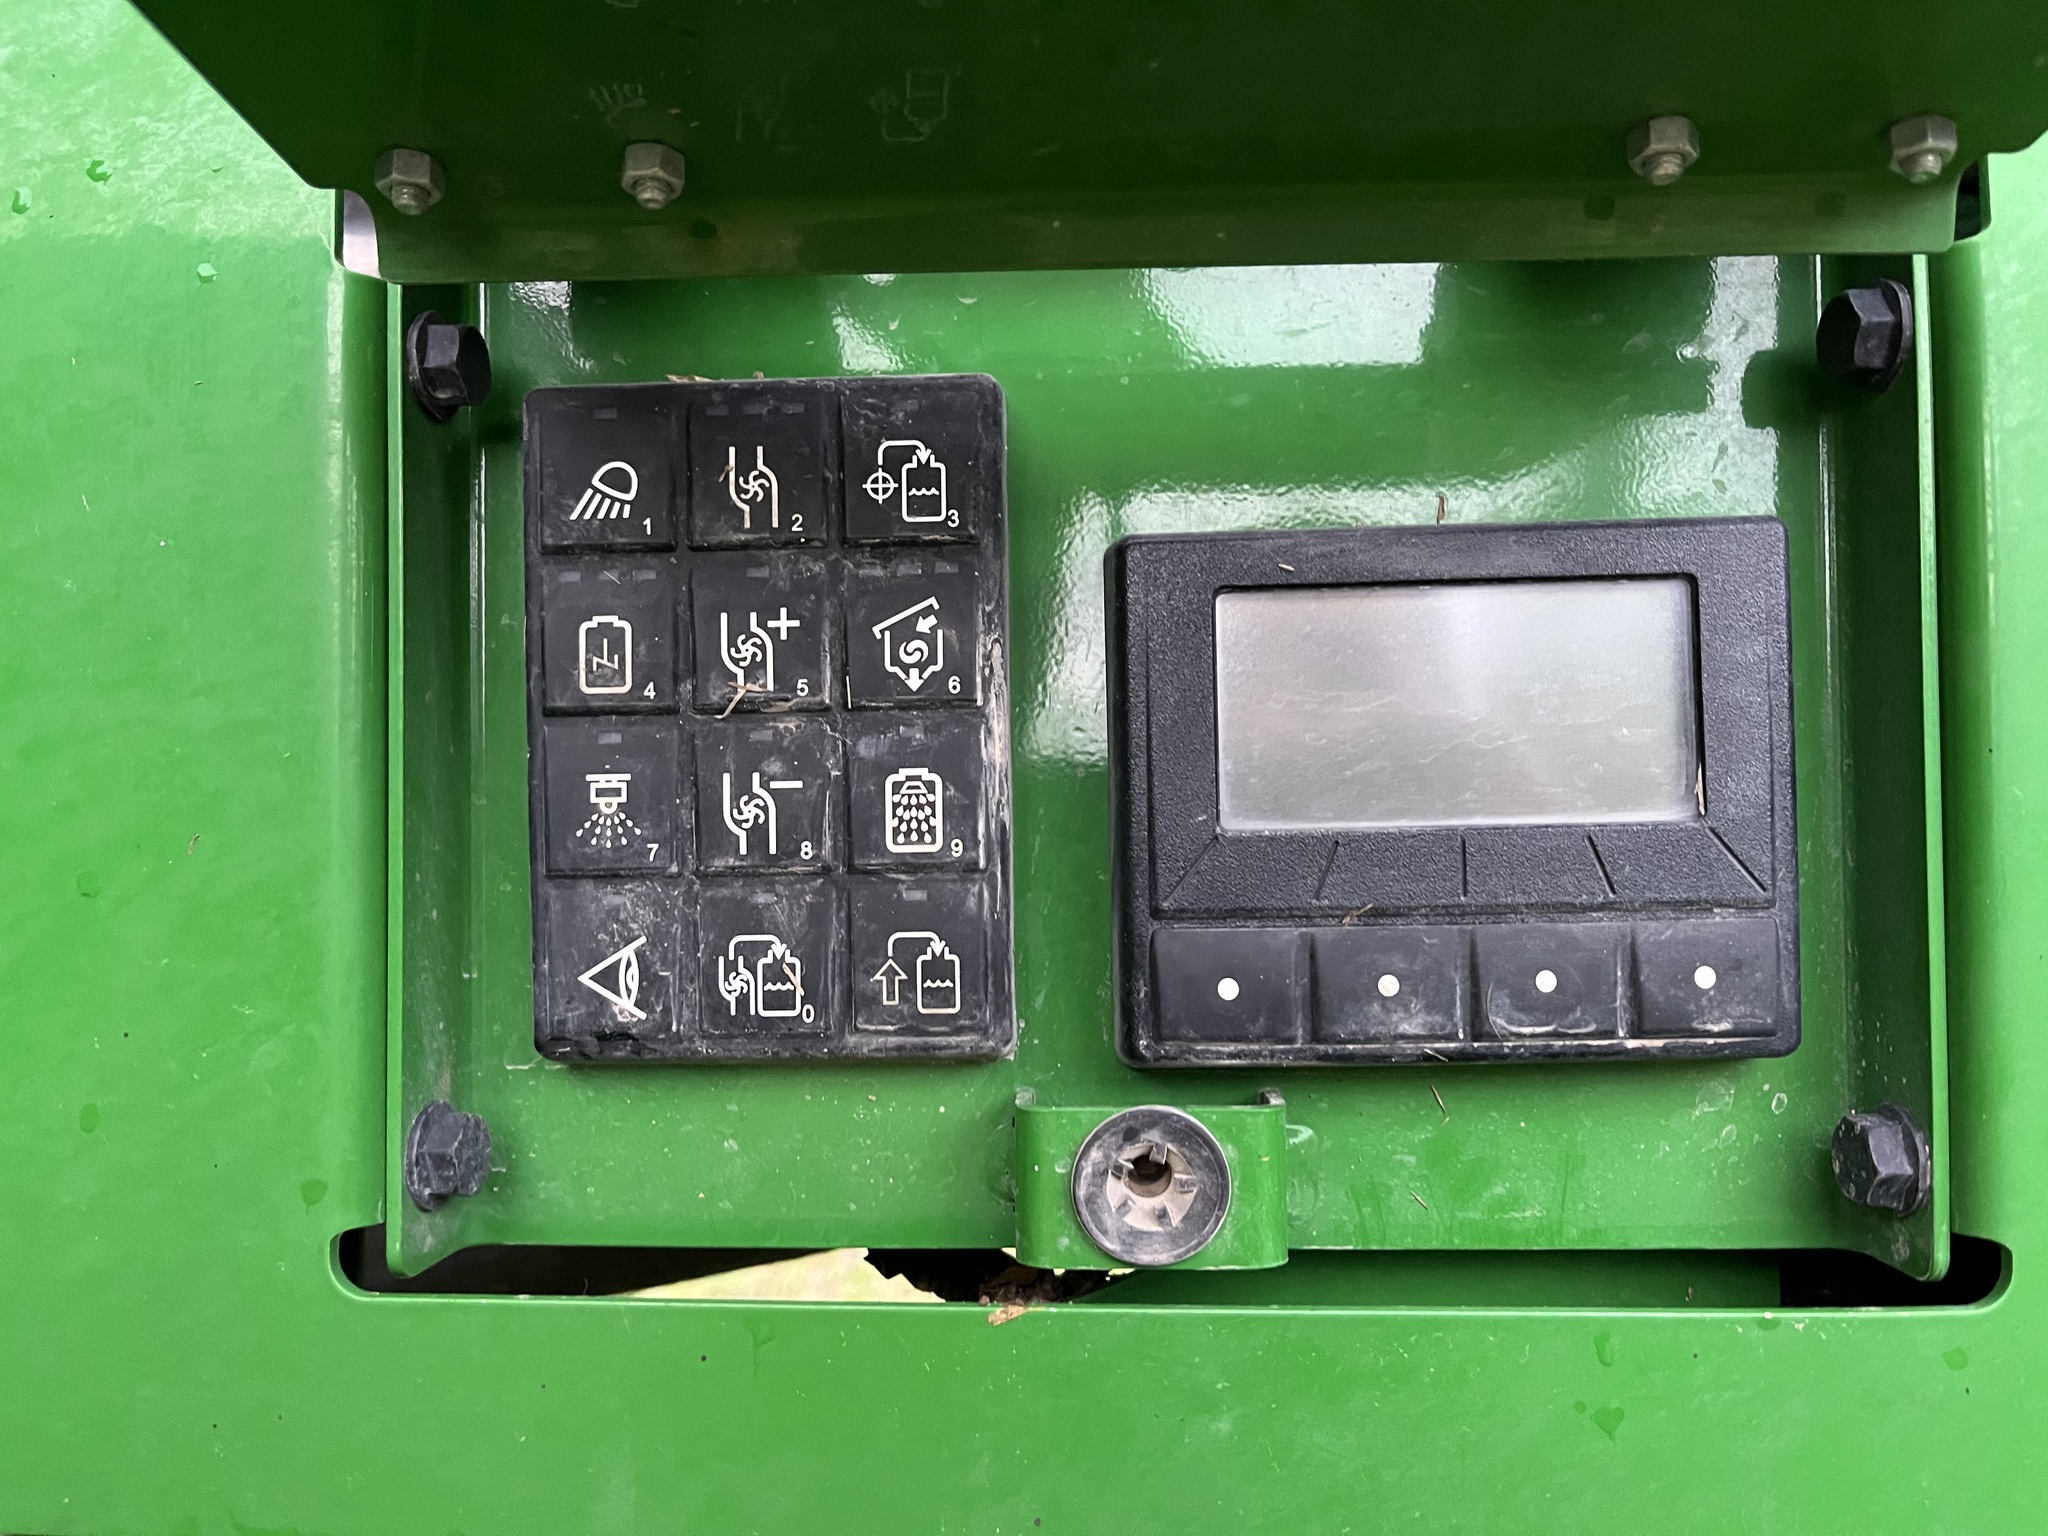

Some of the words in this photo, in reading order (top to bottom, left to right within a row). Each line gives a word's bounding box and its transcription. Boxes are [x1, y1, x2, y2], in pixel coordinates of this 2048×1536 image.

[641, 517, 652, 536] 1
[790, 513, 804, 532] 2
[946, 509, 960, 528] 3
[642, 681, 657, 700] 4
[795, 678, 810, 697] 5
[947, 675, 962, 694] 6
[646, 843, 660, 862] 7
[799, 840, 814, 860] 8
[950, 838, 964, 858] 9
[801, 1004, 815, 1024] 0
